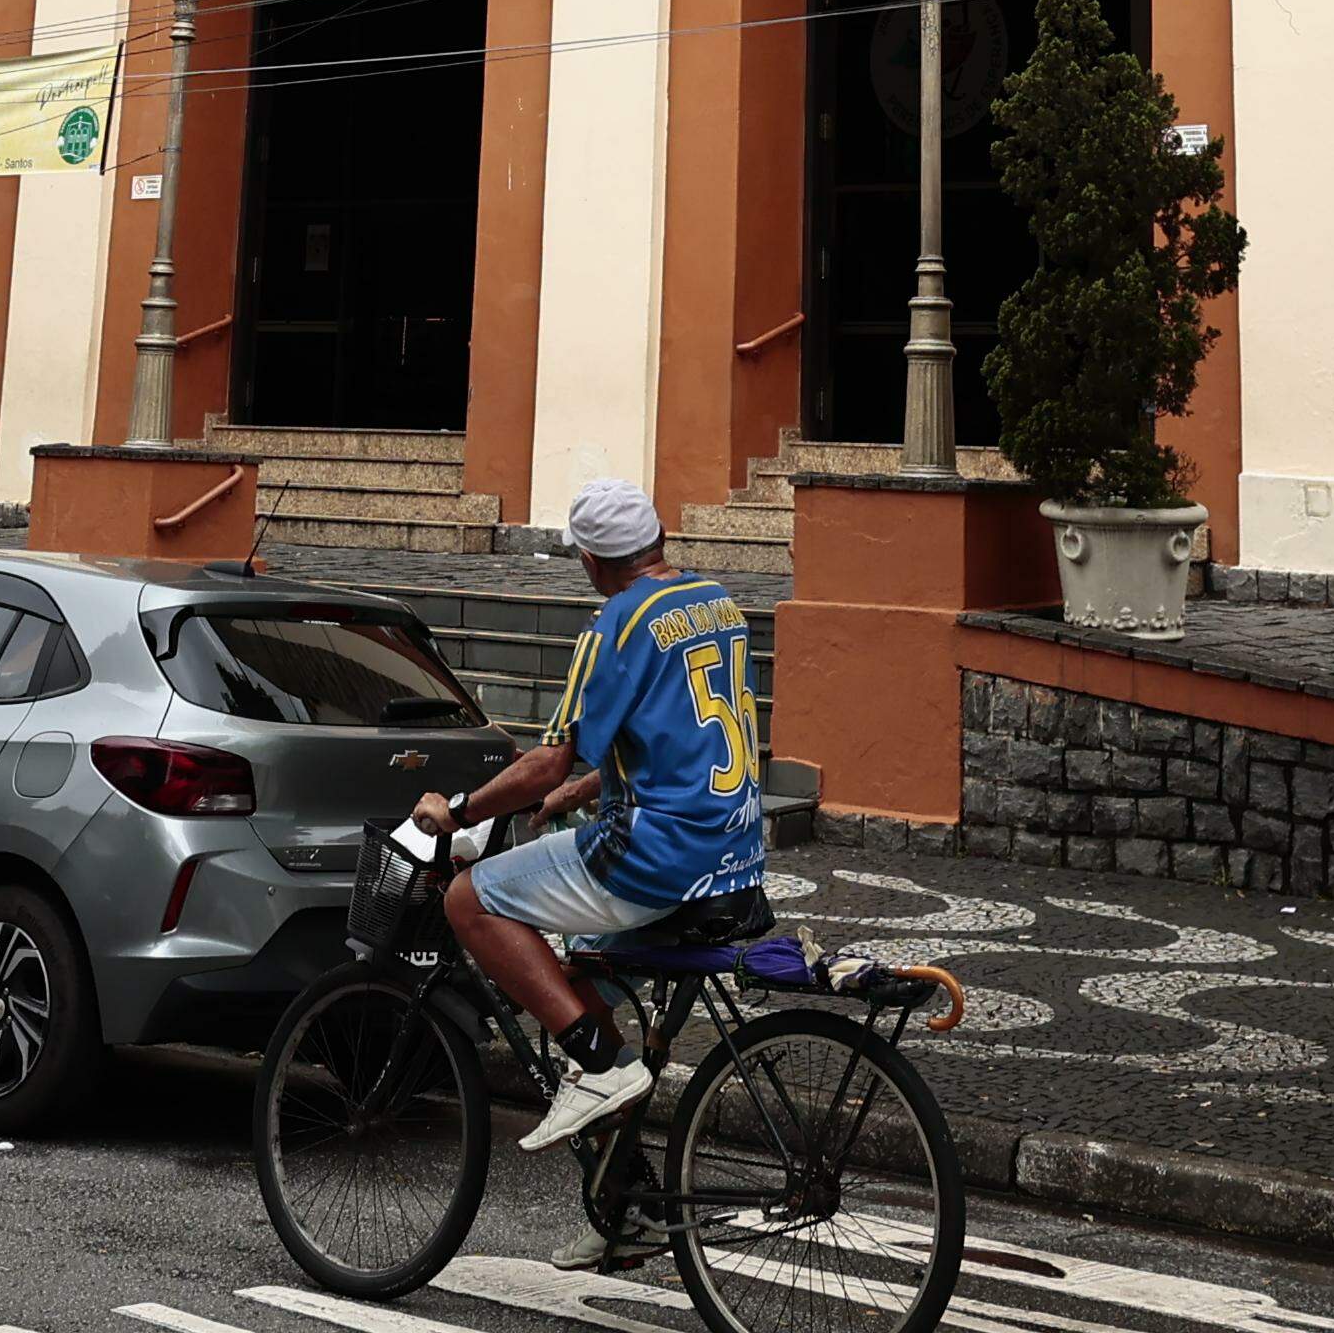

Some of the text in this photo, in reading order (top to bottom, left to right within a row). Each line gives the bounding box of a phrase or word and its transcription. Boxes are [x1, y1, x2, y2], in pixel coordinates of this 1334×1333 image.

[4, 157, 34, 170] Santos
[648, 608, 696, 652] BAR
[686, 602, 717, 635] DO
[683, 635, 761, 797] 56
